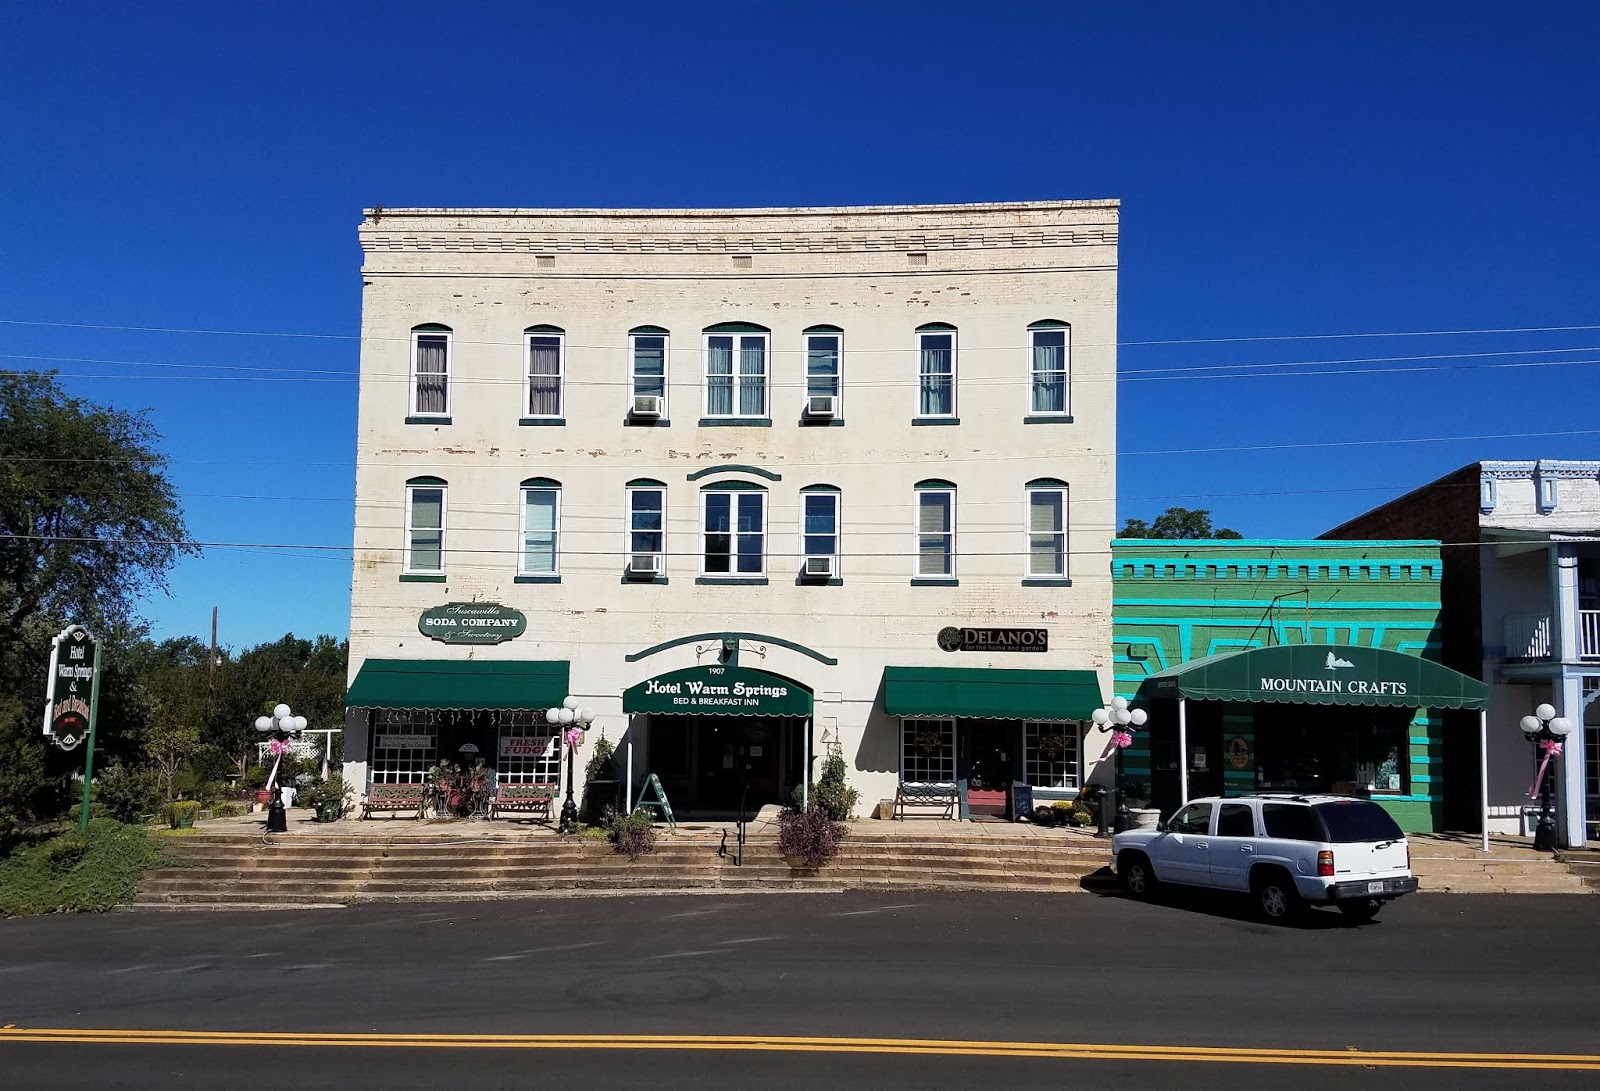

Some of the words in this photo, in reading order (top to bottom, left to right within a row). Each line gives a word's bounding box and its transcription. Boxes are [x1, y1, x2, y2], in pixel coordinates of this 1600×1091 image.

[446, 605, 501, 615] Tuscawilla
[425, 618, 457, 626] SODA
[461, 618, 519, 627] COMPANY
[963, 629, 1046, 645] DELANO'S
[69, 645, 85, 660] Hotel
[58, 664, 74, 678] Warm
[73, 662, 93, 682] Springs
[708, 667, 725, 675] 1907
[69, 681, 78, 692] &
[645, 680, 681, 695] Hotel
[685, 681, 729, 695] Warm
[732, 682, 788, 698] Springs
[1260, 677, 1343, 693] MOUNTAIN
[1347, 680, 1407, 695] CRAFTS
[673, 697, 689, 705] BED
[690, 697, 697, 705] &
[698, 697, 743, 706] BREAKFAST
[744, 698, 759, 706] INN
[504, 746, 550, 755] FUDGE
